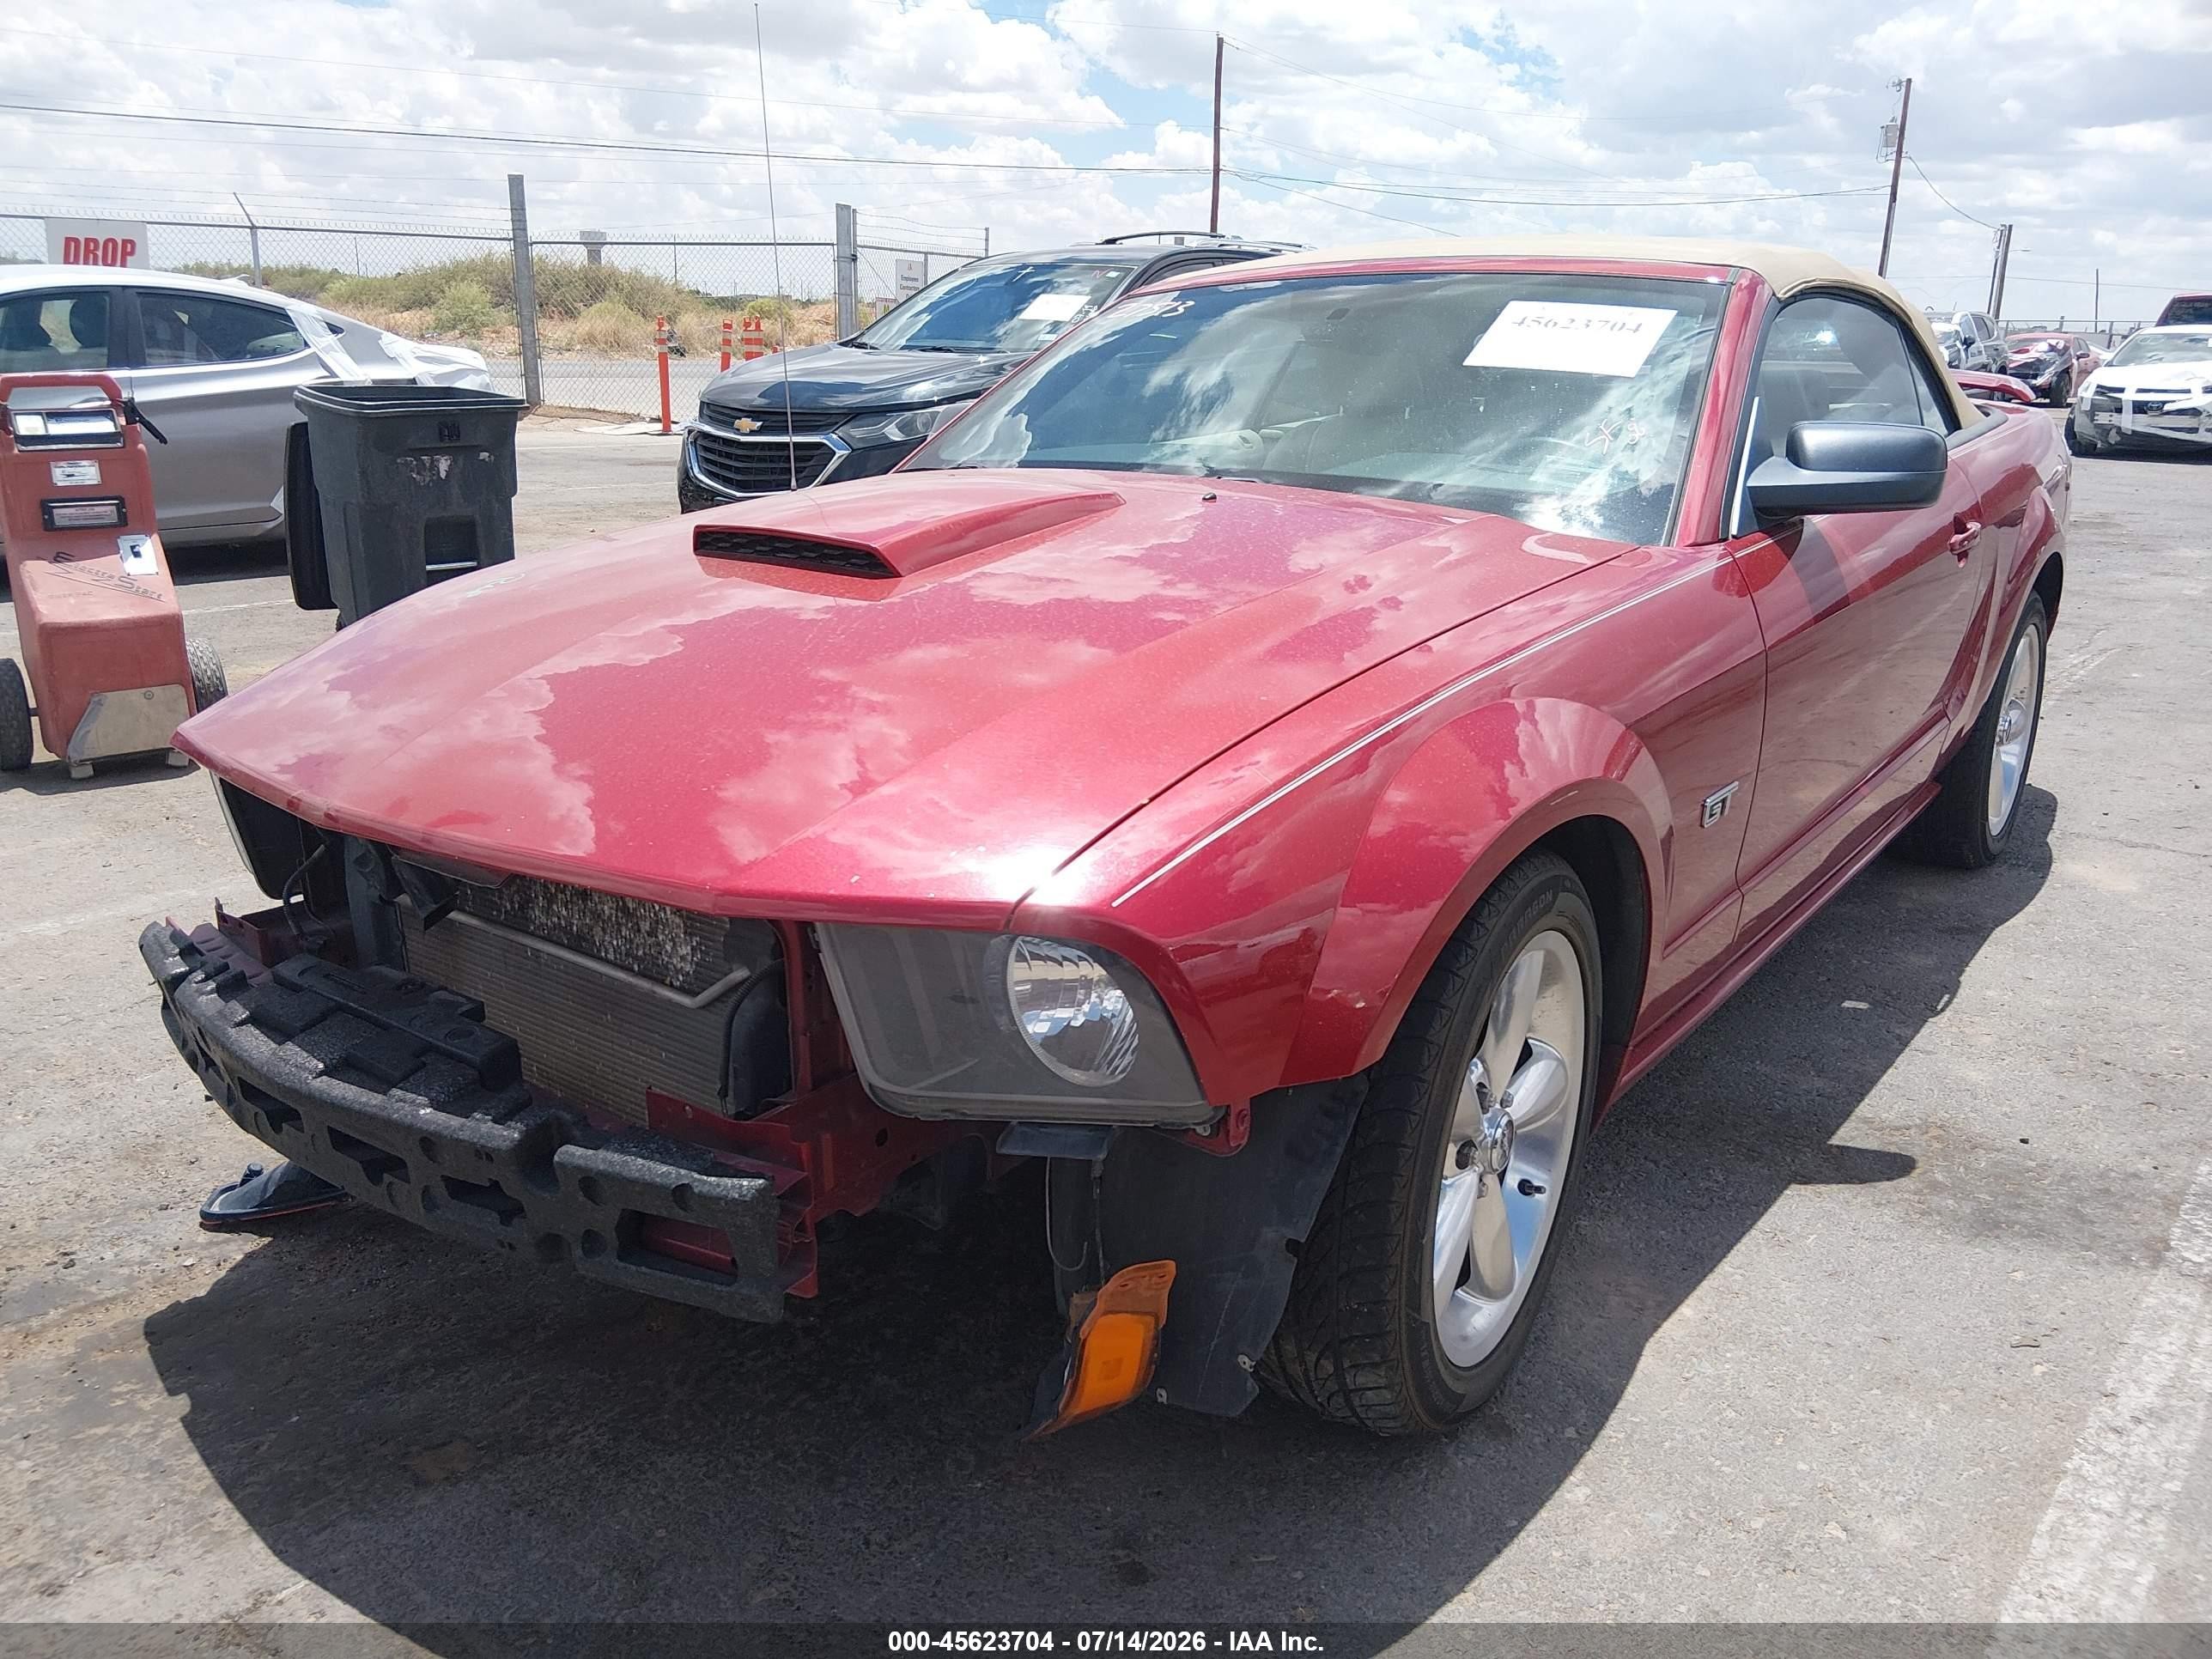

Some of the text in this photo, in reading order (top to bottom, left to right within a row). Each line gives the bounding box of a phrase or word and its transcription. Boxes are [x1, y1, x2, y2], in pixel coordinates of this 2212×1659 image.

[64, 236, 137, 267] DROP
[1511, 316, 1643, 334] 45623704
[1701, 781, 1739, 829] GT
